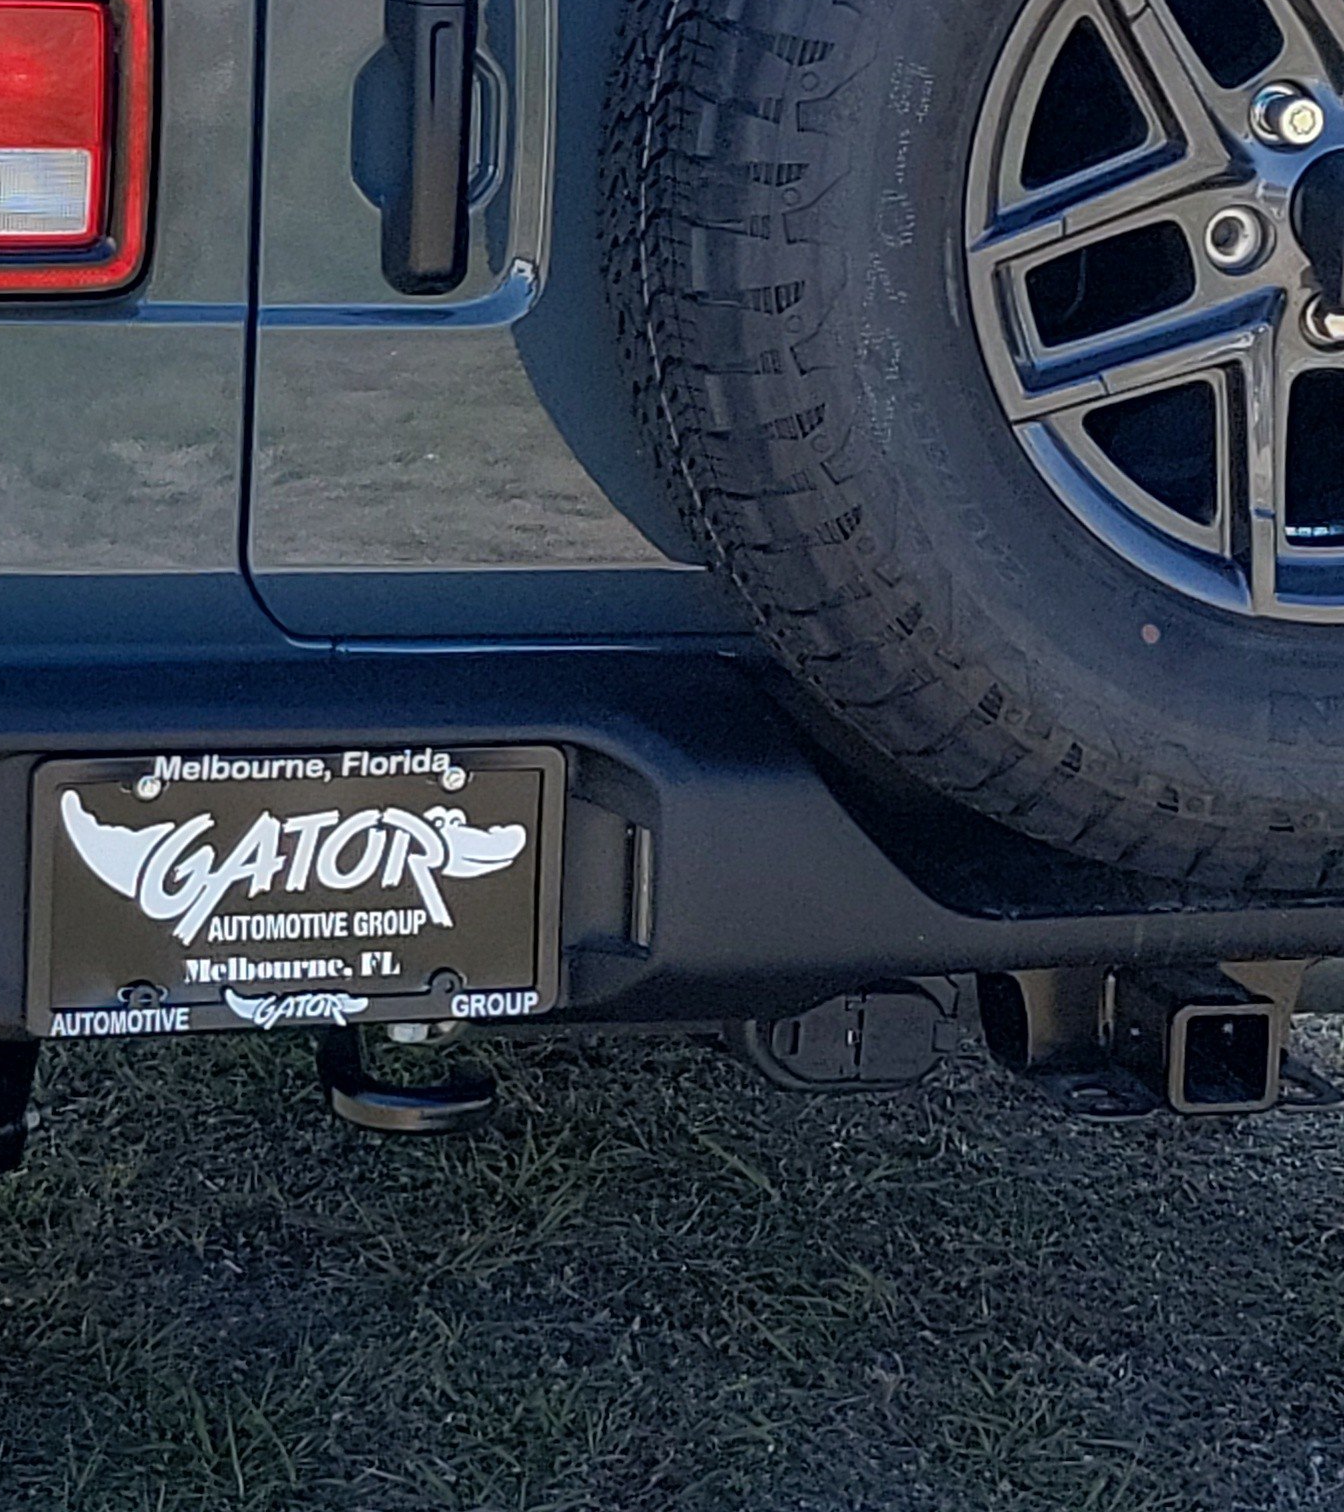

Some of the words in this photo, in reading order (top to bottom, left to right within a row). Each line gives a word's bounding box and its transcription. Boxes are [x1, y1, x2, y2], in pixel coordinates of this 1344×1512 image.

[154, 755, 332, 782] Melbourne,
[342, 748, 450, 775] Florida
[140, 808, 453, 945] GATOR
[208, 912, 348, 942] AUTOMOTIVE
[353, 909, 427, 936] GROUP
[360, 951, 401, 976] FL
[253, 993, 348, 1029] GATOR
[451, 991, 539, 1017] GROUP
[51, 1007, 189, 1036] AUTOMOTIVE
